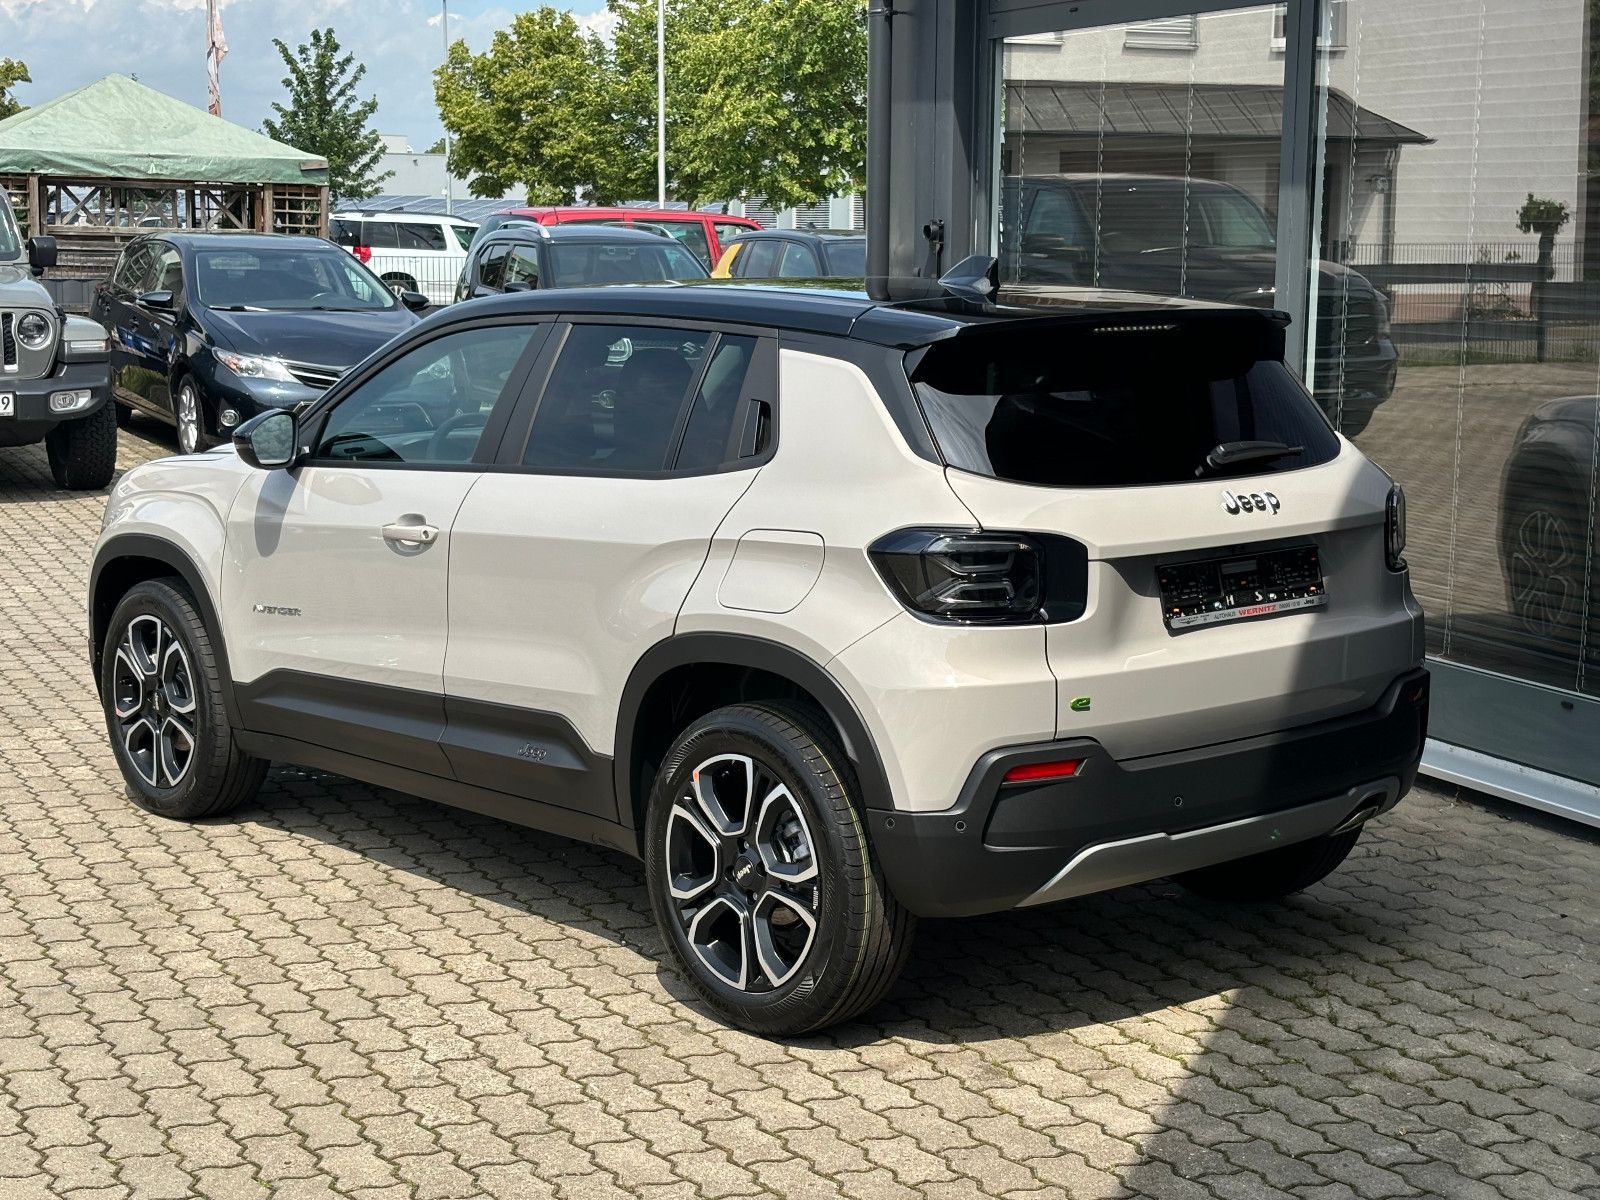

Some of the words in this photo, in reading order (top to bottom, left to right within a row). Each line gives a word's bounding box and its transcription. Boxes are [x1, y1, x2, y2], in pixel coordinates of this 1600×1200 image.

[1, 395, 10, 411] 9
[1221, 489, 1281, 515] Jeep
[252, 604, 302, 616] AVENGER
[1238, 604, 1277, 616] WERNITZ
[517, 743, 547, 761] Jeep
